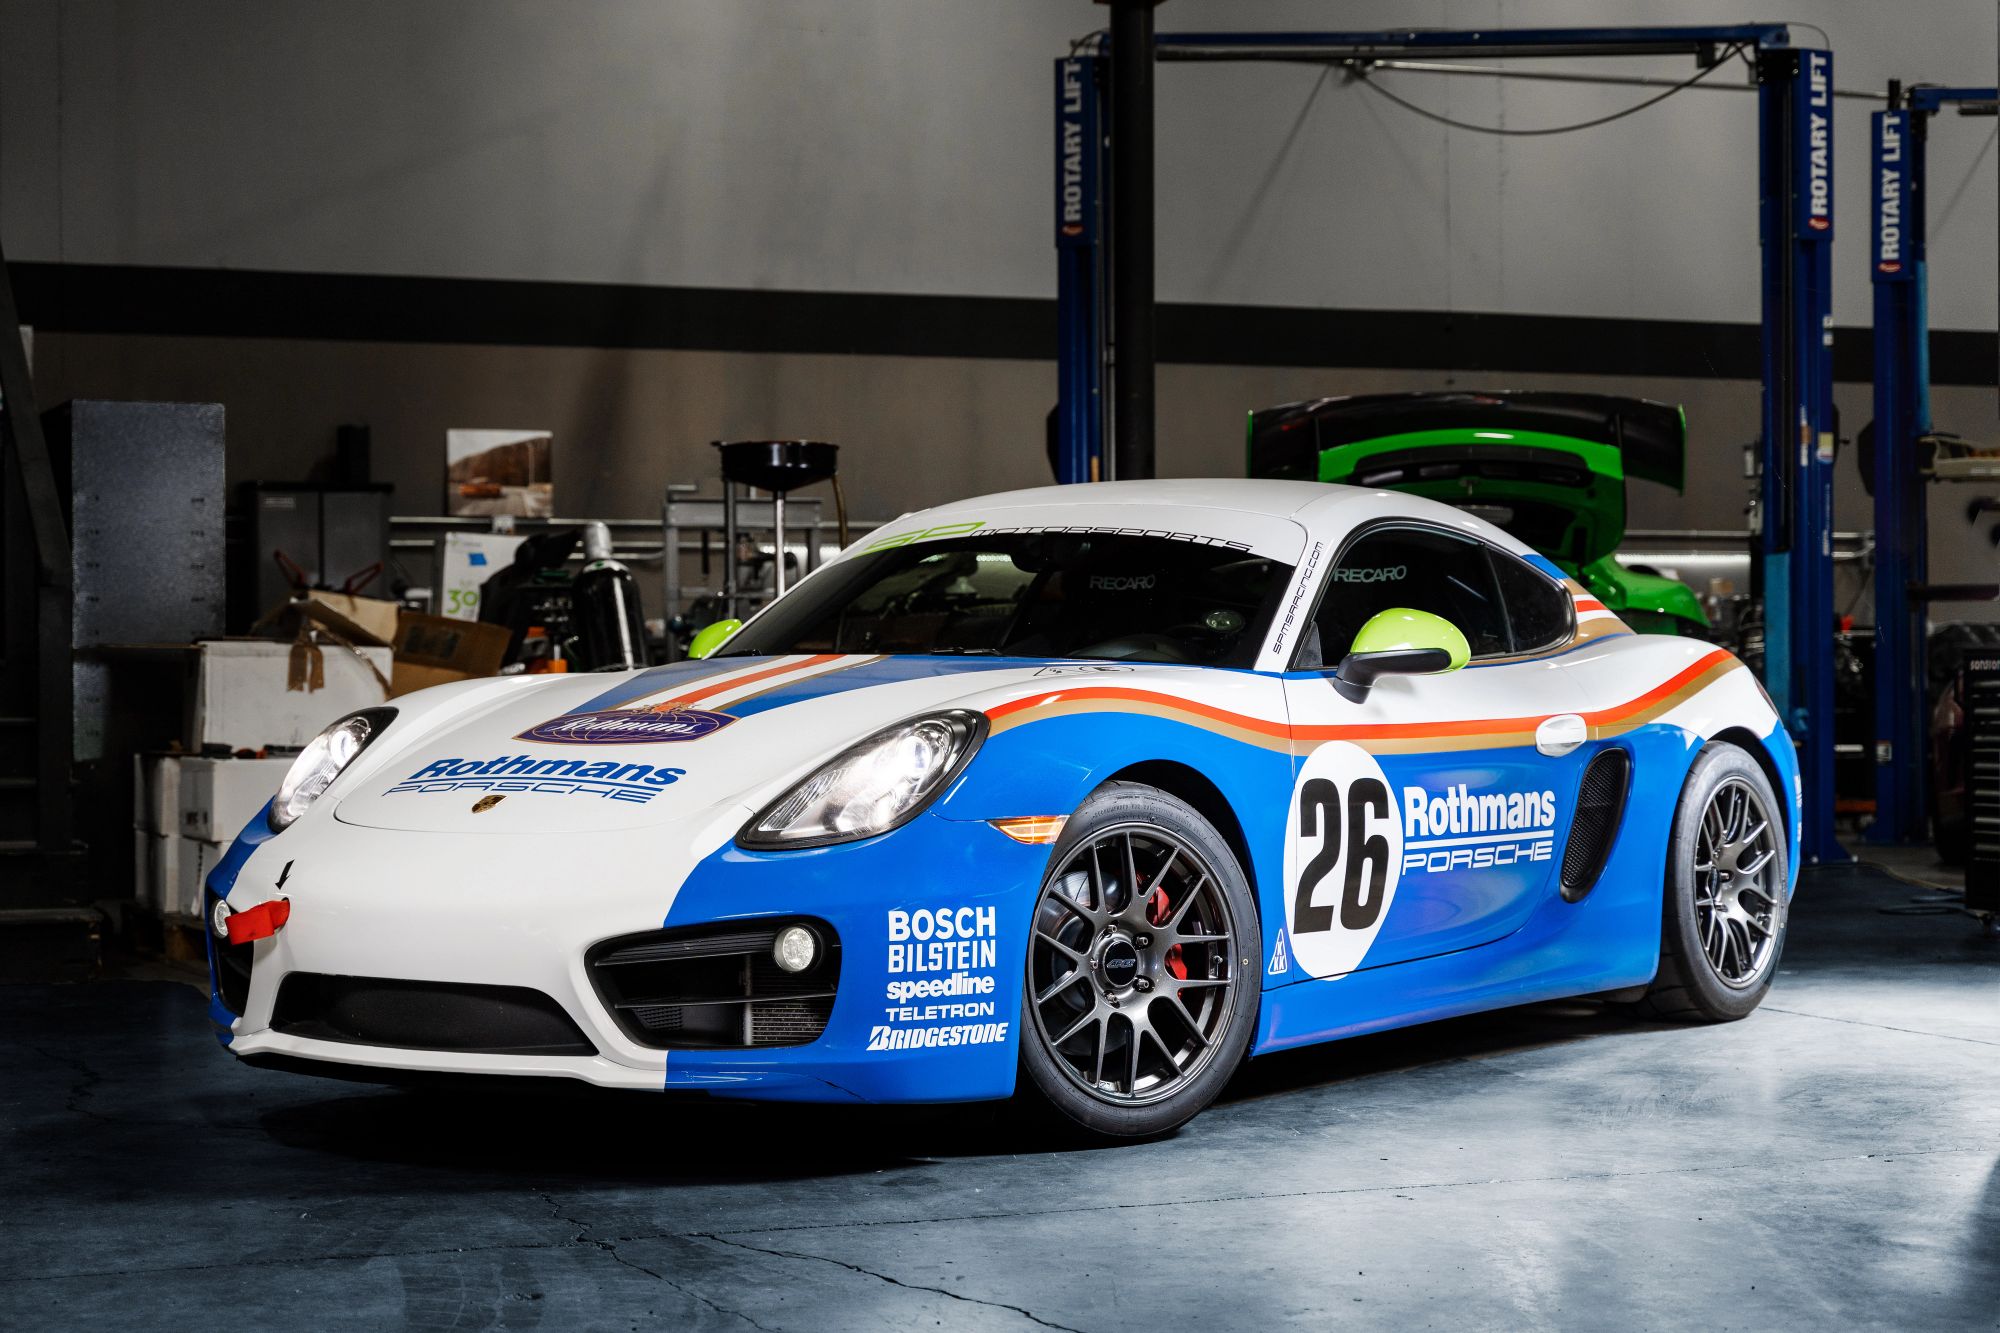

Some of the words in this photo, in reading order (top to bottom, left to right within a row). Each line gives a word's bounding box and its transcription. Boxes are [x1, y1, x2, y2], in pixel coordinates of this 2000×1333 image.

[1063, 62, 1082, 113] LIFT
[1810, 52, 1828, 107] LIFT
[1882, 113, 1900, 162] LIFT
[1064, 121, 1082, 222] ROTARY
[1810, 112, 1828, 216] ROTARY
[1881, 168, 1900, 260] ROTARY
[1088, 573, 1157, 591] RECARO
[1333, 564, 1407, 583] RECARO
[544, 717, 702, 734] Rothmans
[408, 754, 687, 786] Rothmans
[381, 782, 665, 804] PORSCHE
[1403, 784, 1556, 837] Rothmans
[1293, 777, 1390, 935] 26
[1402, 840, 1553, 875] PORSCHE
[888, 906, 996, 942] BOSCH
[888, 939, 996, 973] BILSTEIN
[886, 971, 995, 1004] speedline
[885, 1002, 995, 1022] TELETRON
[866, 1022, 1009, 1051] BRIDGESTONE
